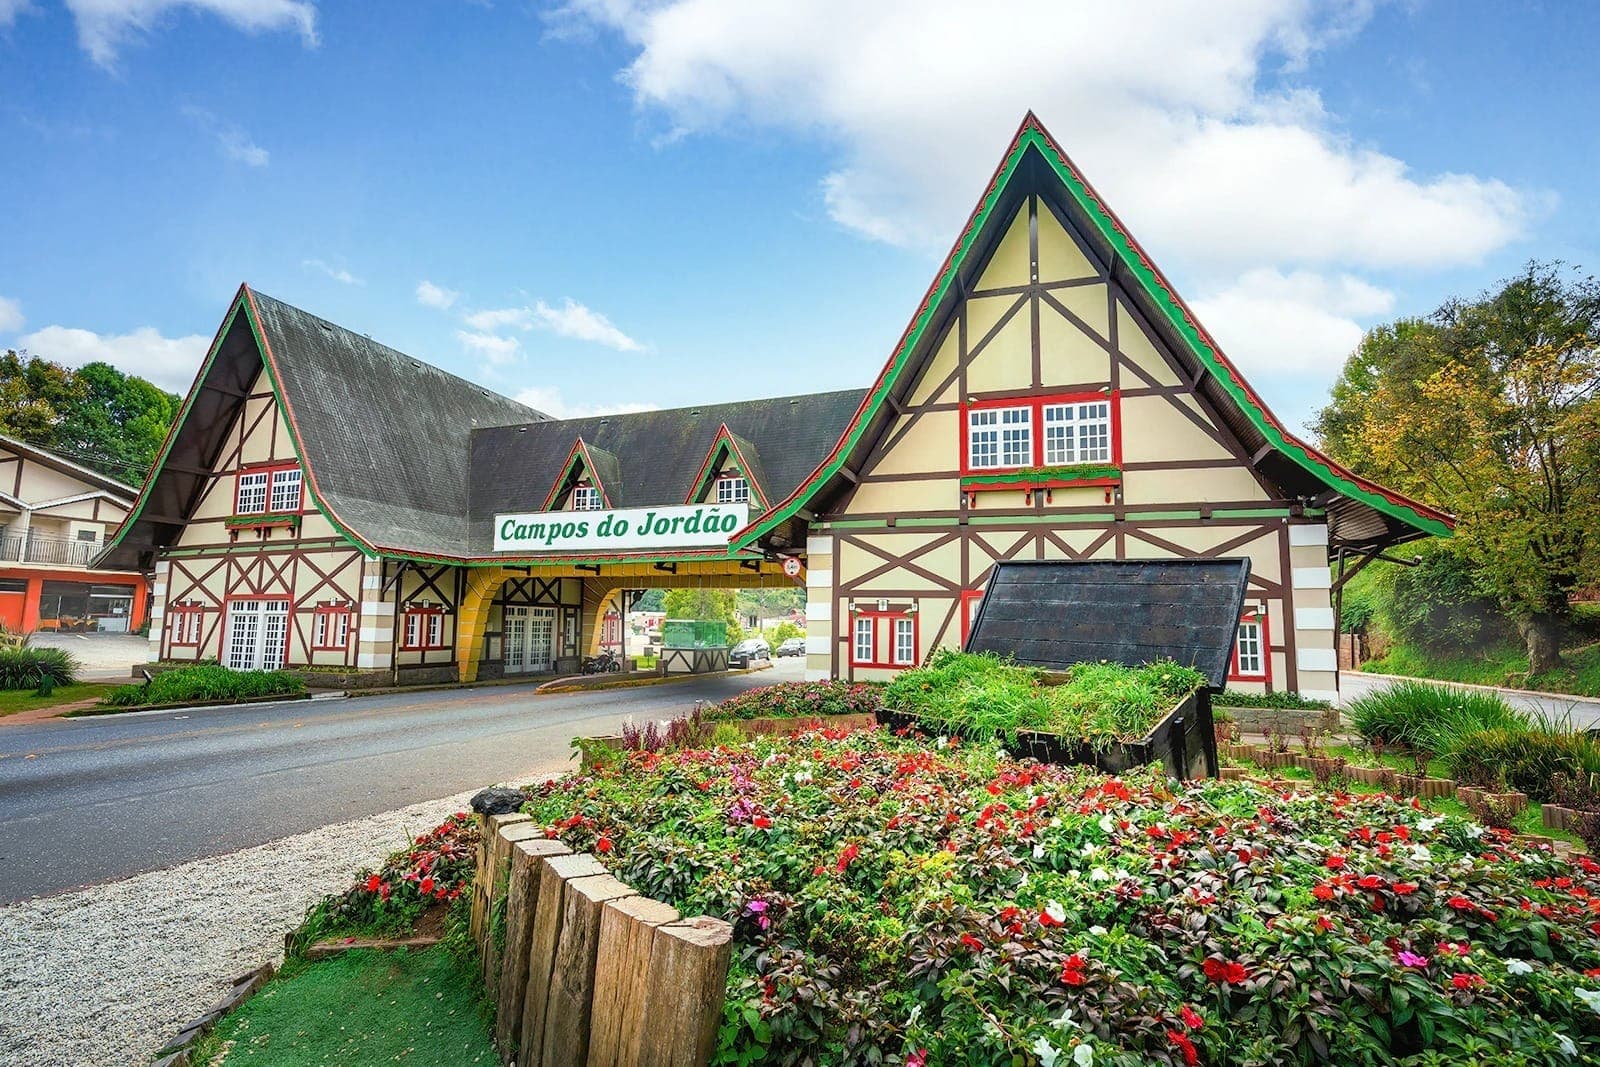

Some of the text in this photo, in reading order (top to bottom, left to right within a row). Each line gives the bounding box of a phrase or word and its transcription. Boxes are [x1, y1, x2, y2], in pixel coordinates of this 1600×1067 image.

[500, 507, 738, 546] Campos do Jordão
